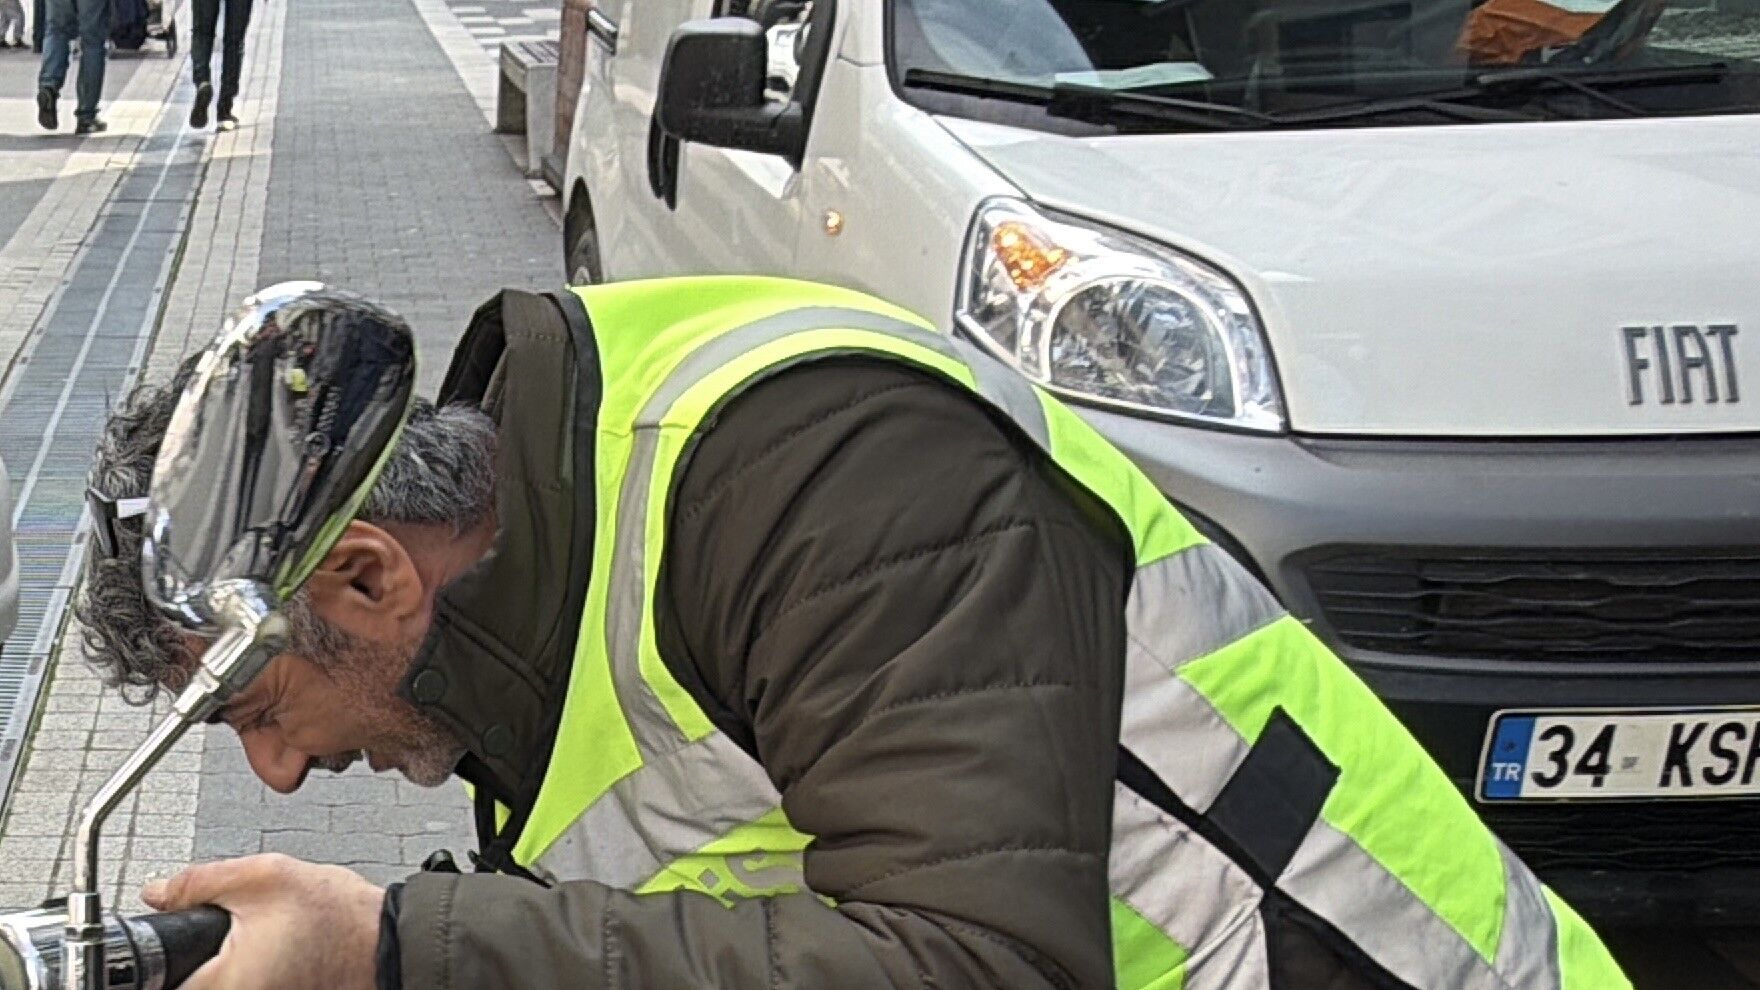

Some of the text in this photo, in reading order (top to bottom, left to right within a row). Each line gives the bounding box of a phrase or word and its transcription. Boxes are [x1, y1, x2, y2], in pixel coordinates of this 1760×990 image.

[1622, 324, 1740, 406] FIAT
[1492, 762, 1520, 782] TR
[1531, 723, 1617, 788] 34
